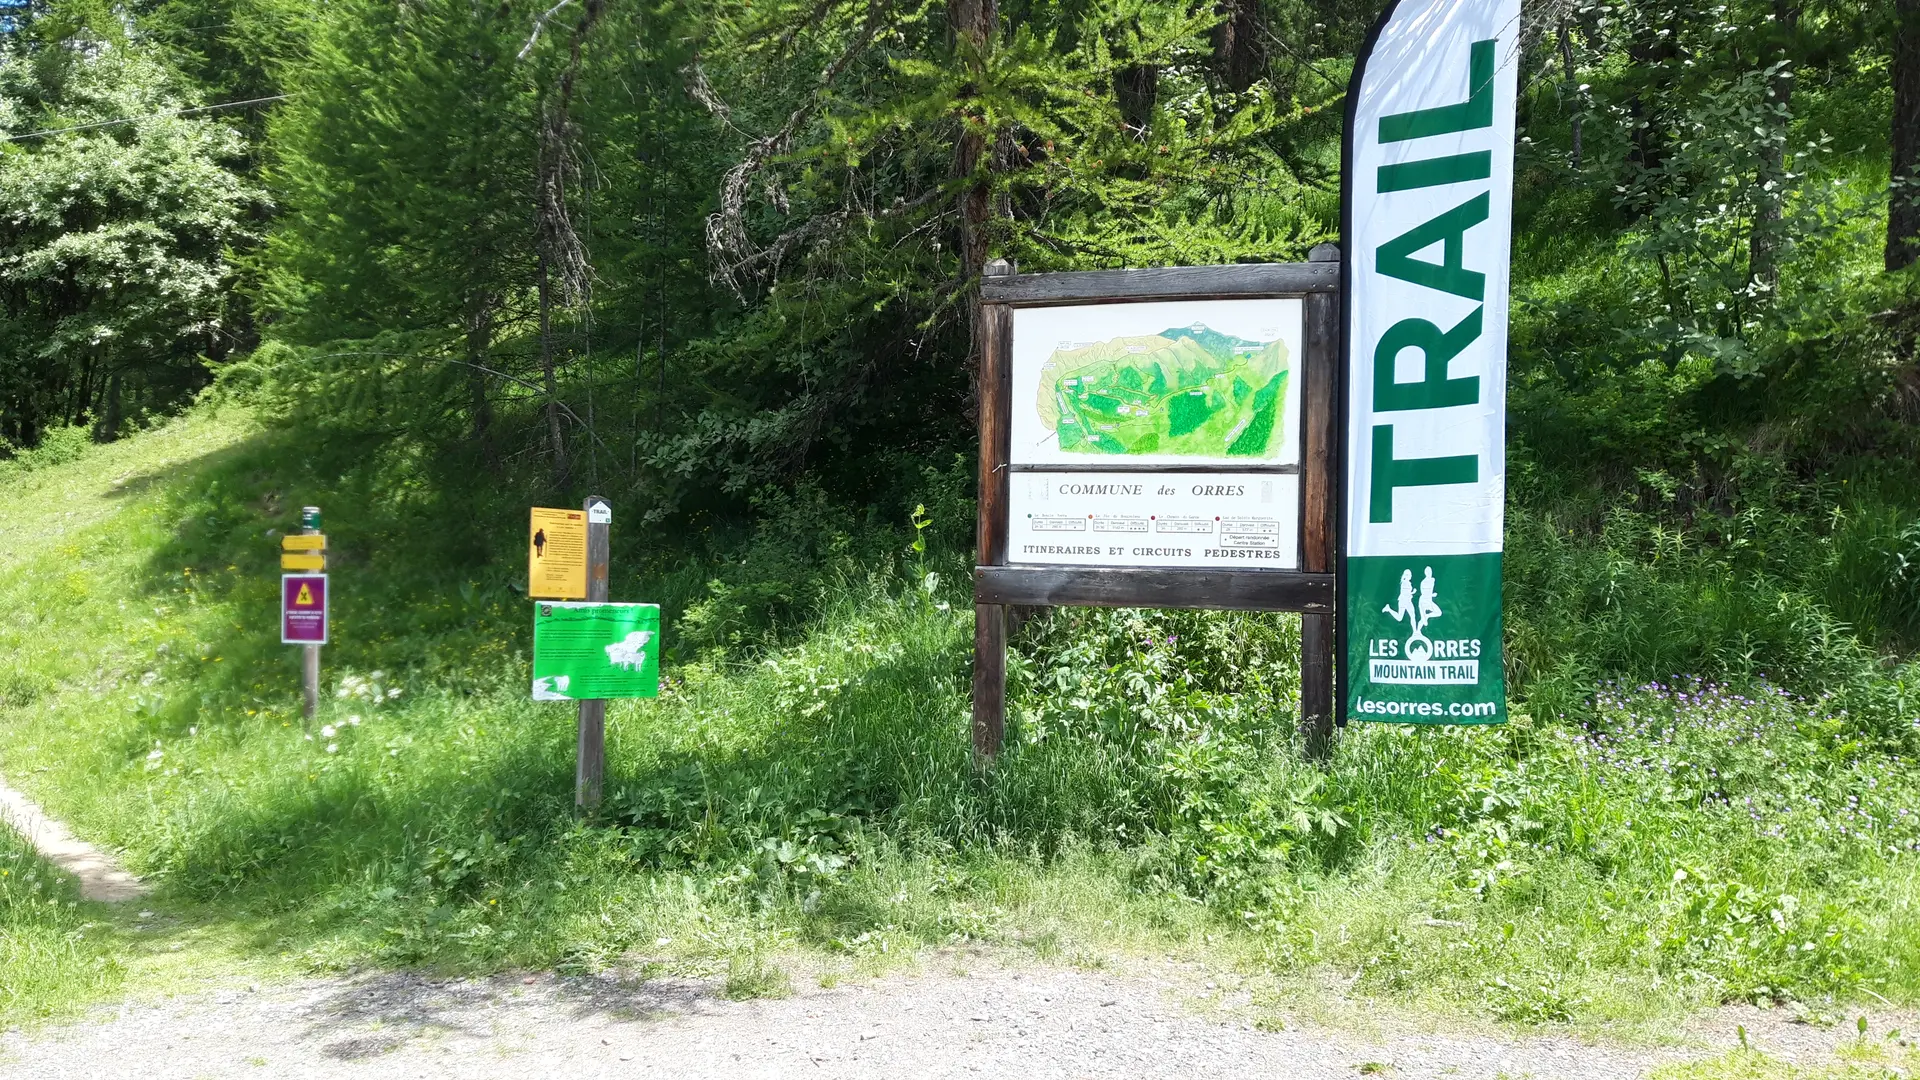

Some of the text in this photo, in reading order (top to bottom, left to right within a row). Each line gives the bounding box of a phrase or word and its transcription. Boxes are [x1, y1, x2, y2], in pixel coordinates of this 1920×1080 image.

[1369, 38, 1496, 524] TRAIL
[1059, 484, 1245, 496] COMMUNE des ORRES
[1023, 545, 1281, 559] ITINERAIRES ET CIRCUITS PEDESTRES
[1369, 635, 1481, 661] LES ORRES
[1373, 664, 1476, 680] MOUNTAIN TRAIL
[1356, 696, 1497, 716] lesorres.com
